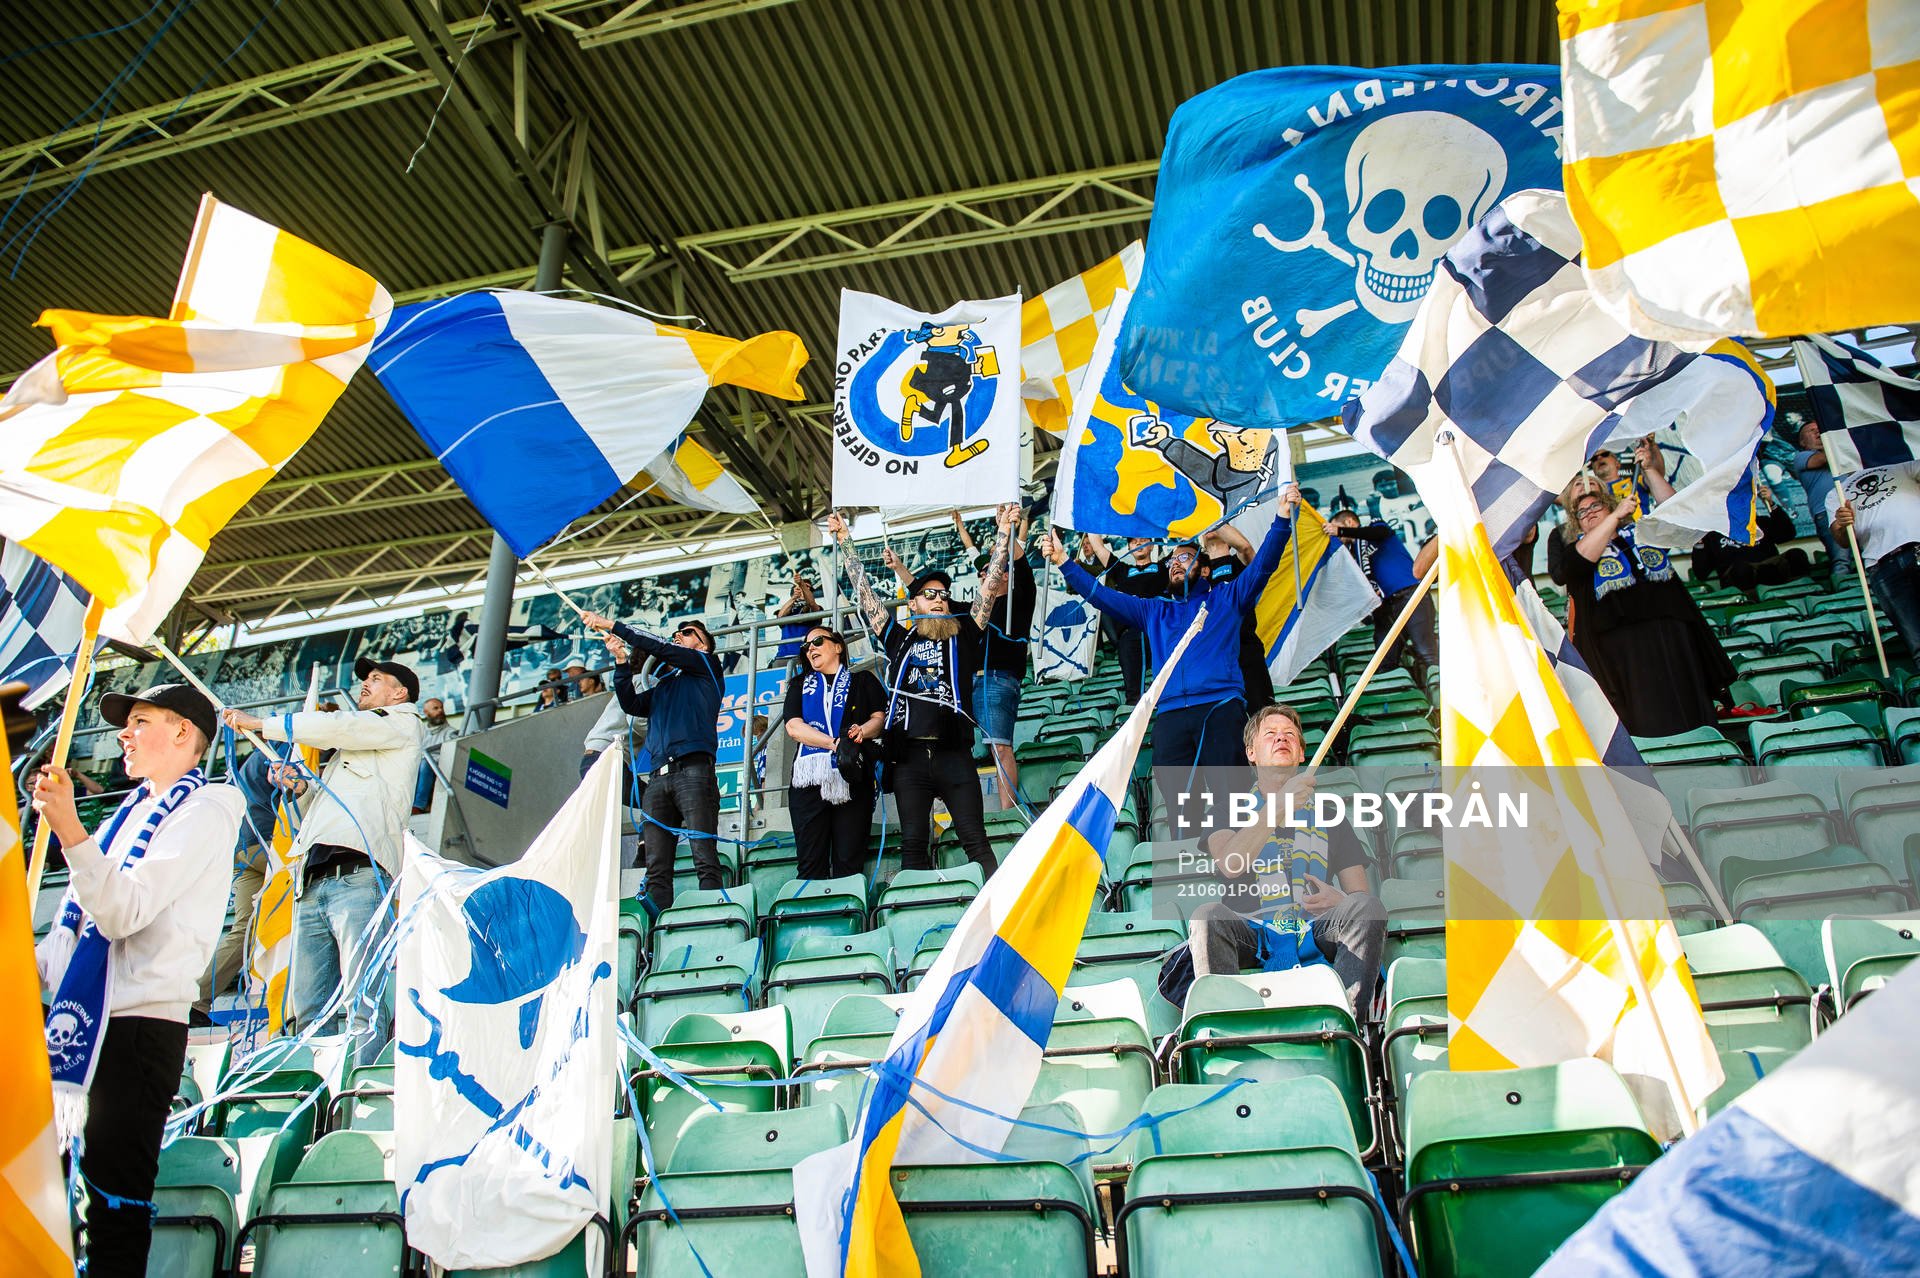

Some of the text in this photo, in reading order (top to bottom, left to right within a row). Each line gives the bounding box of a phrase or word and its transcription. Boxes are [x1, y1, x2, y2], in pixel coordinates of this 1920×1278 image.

[835, 361, 852, 391] NO
[885, 459, 919, 475] NO
[718, 736, 741, 749] från
[49, 1000, 93, 1028] TRONERNA
[63, 1053, 85, 1071] CLUB
